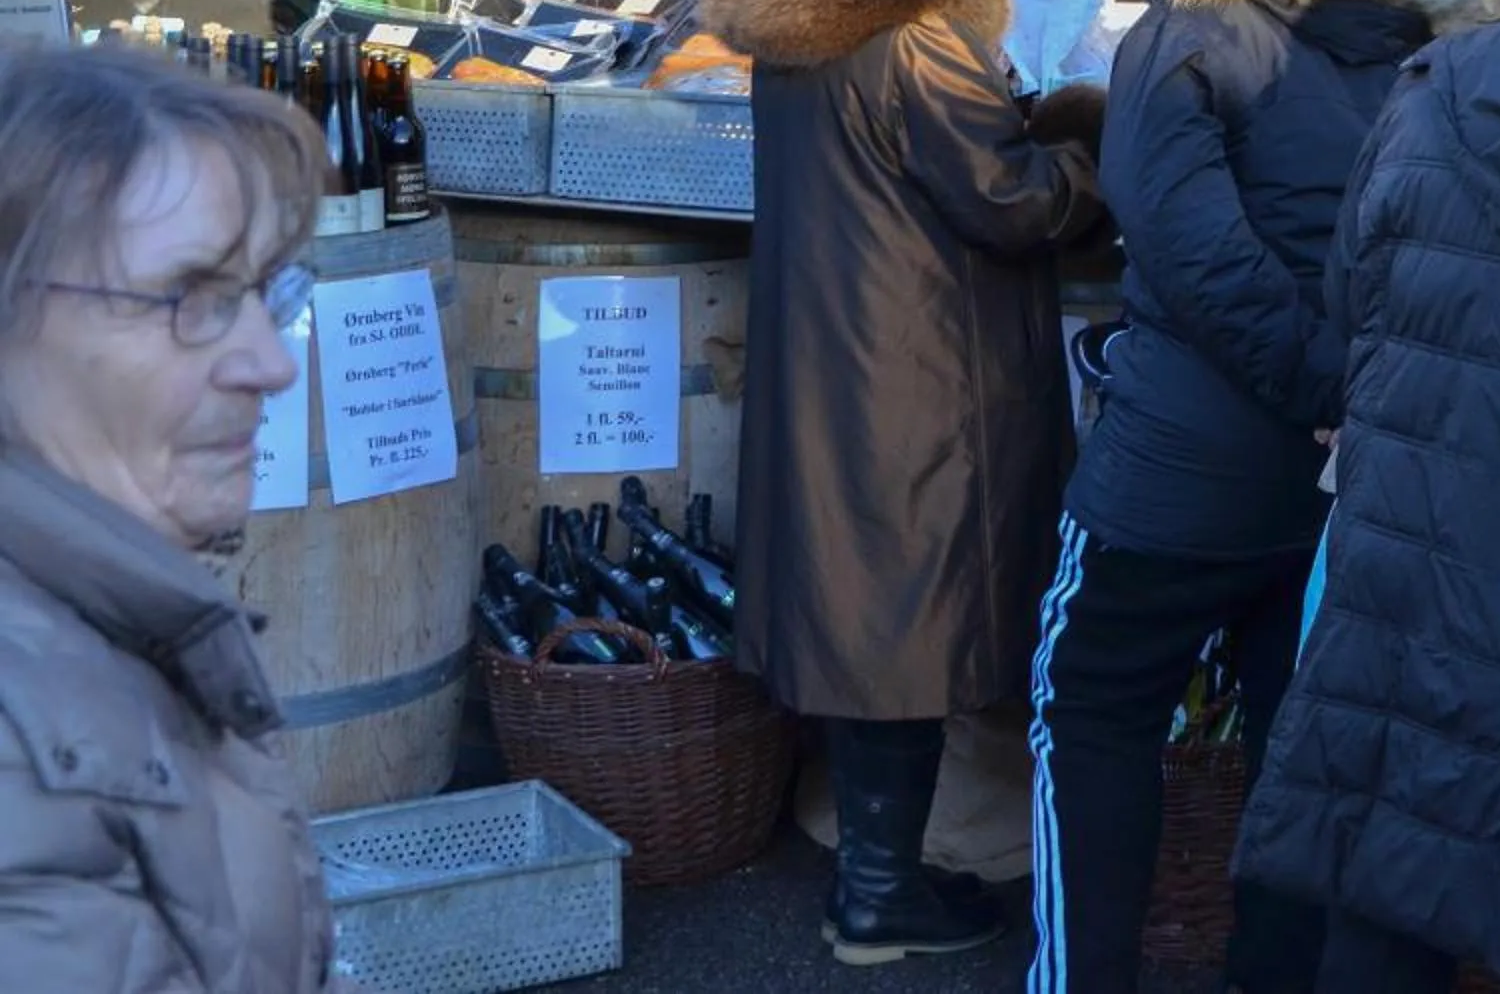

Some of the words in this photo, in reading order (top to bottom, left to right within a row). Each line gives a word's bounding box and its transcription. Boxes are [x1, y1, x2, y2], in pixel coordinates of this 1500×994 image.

[344, 308, 403, 328] Ørnberg
[404, 302, 426, 317] Vin
[584, 307, 648, 322] TILBUD
[348, 332, 367, 346] fra
[575, 432, 584, 445] 2
